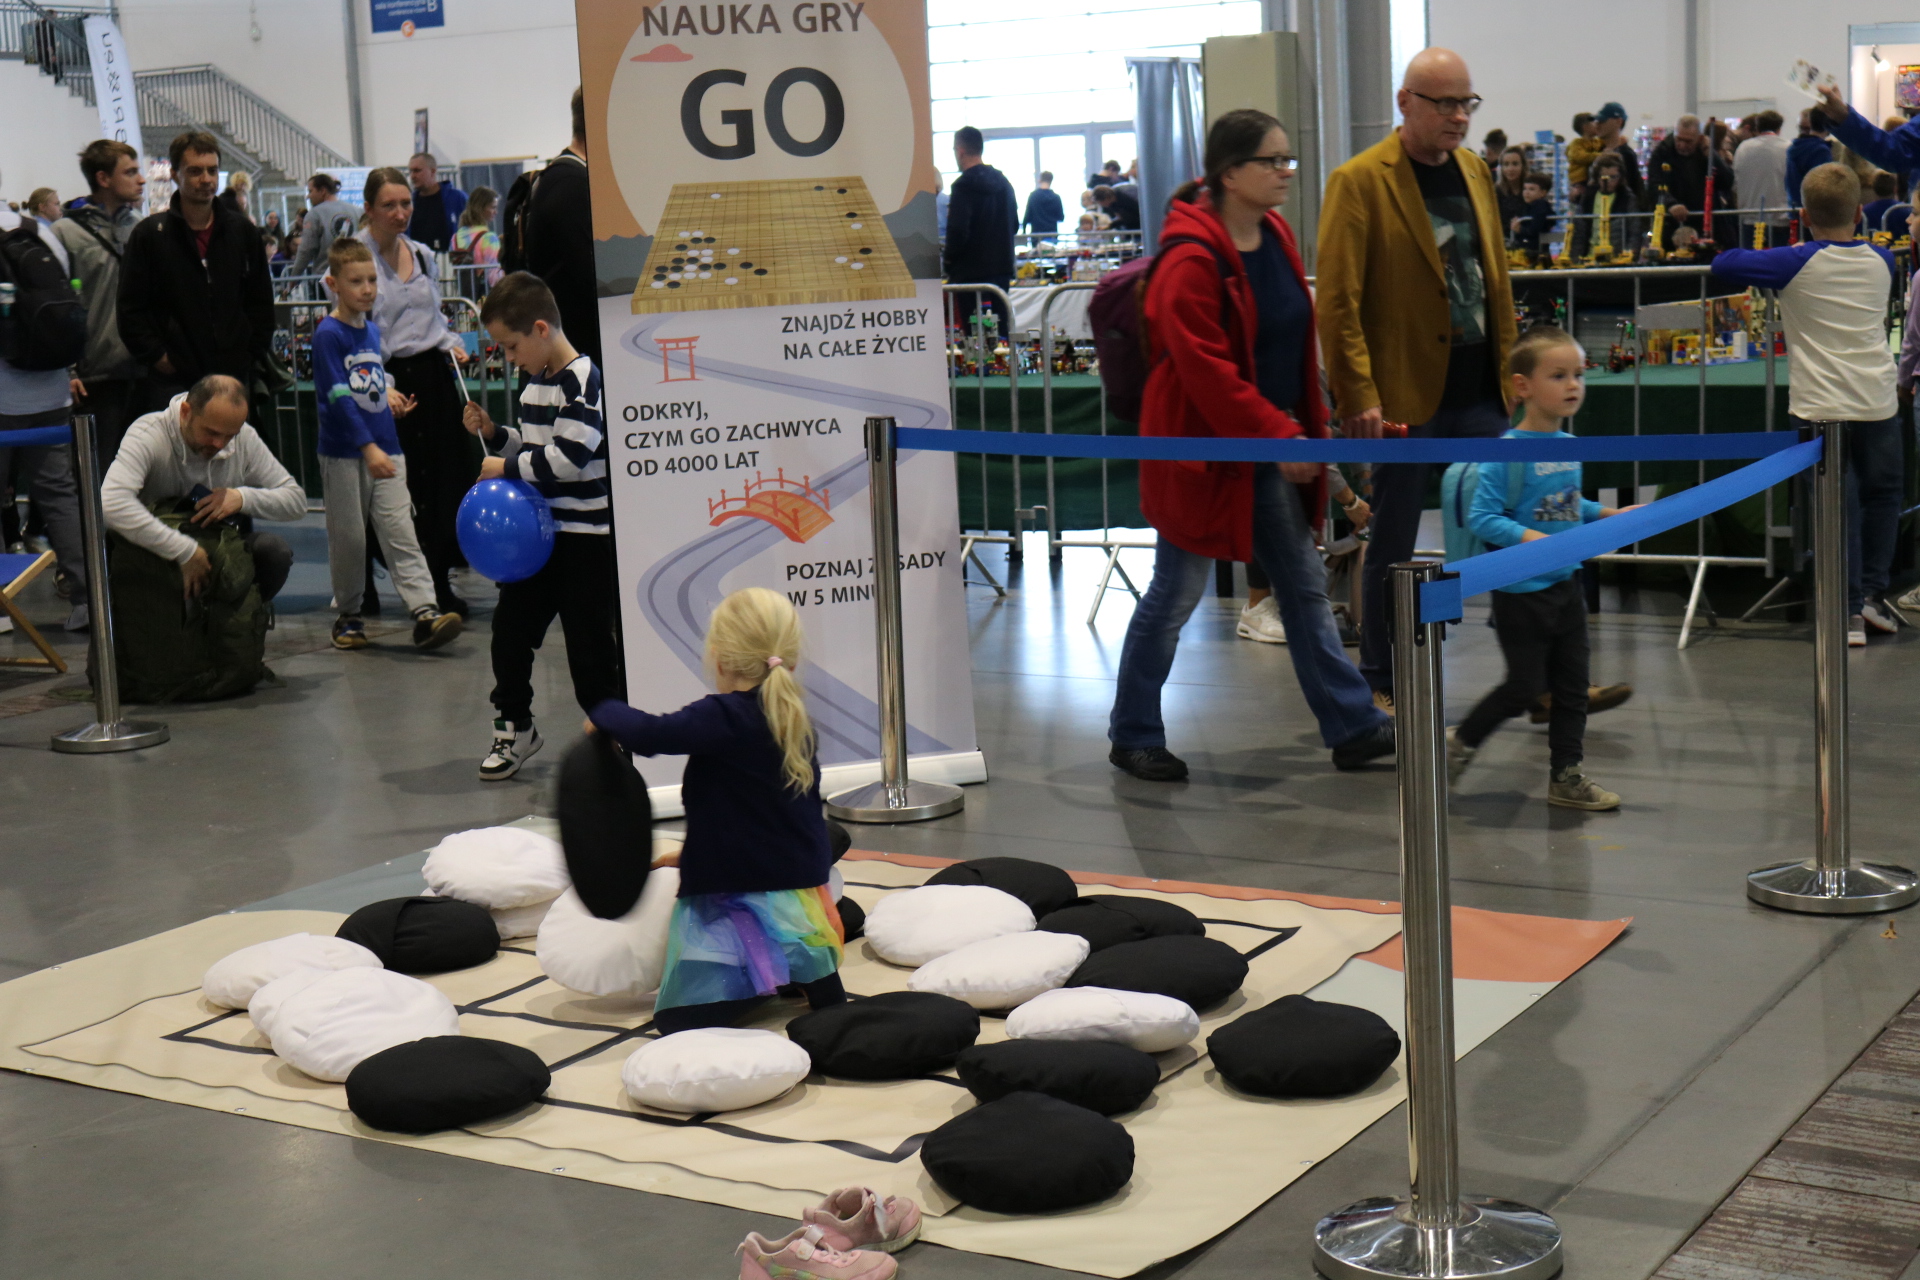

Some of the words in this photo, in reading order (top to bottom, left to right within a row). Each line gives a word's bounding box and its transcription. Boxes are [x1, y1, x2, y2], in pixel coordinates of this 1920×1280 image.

[643, 3, 782, 37] NAUKA
[793, 2, 865, 33] GRY
[680, 66, 845, 161] GO
[781, 309, 855, 334] ZNAJDŹ
[861, 308, 929, 328] HOBBY
[783, 341, 813, 360] NA
[818, 338, 867, 358] CAŁE
[872, 334, 927, 354] ŻYCIE
[622, 400, 709, 422] ODKRYJ,
[624, 430, 684, 450] CZYM
[690, 426, 720, 444] GO
[726, 417, 842, 442] ZACHWYCA
[626, 459, 659, 477] OD
[665, 454, 718, 475] 4000
[724, 451, 760, 470] LAT
[786, 558, 862, 581] POZNAJ
[868, 551, 946, 575] SADY
[788, 590, 807, 607] W
[814, 589, 825, 605] 5
